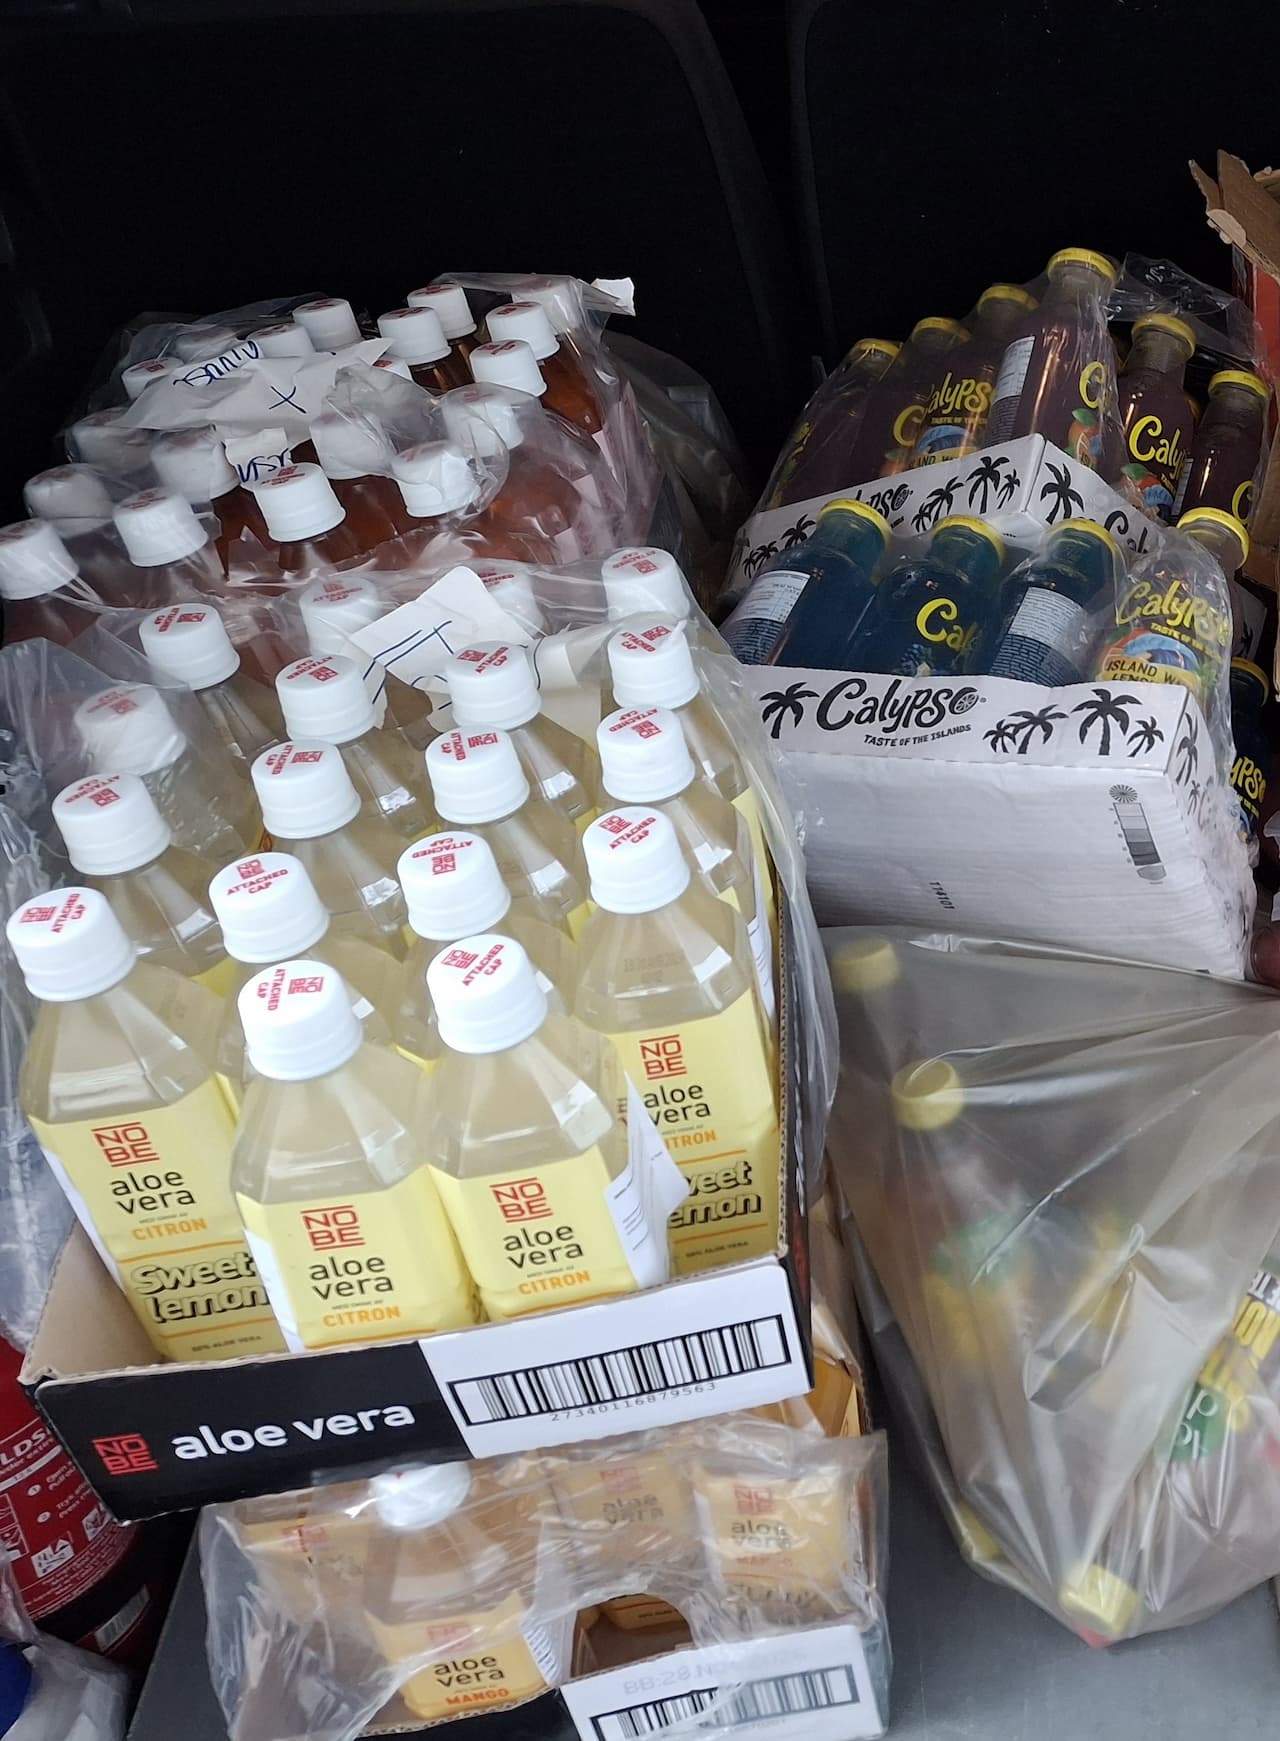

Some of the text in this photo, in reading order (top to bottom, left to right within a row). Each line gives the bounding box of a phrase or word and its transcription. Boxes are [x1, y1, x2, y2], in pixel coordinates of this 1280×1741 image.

[1106, 659, 1158, 677] ISLAND
[816, 678, 980, 734] Calypso
[864, 723, 972, 747] TASTE OF THE ISLANDS
[429, 837, 454, 847] CAP
[609, 817, 656, 849] ATTACHED
[630, 830, 650, 844] CAP
[412, 840, 473, 859] ATTACHED
[227, 869, 289, 895] ATTACHED
[248, 882, 272, 894] CAP
[461, 944, 505, 987] ATTACHED
[482, 958, 504, 976] CAP
[256, 982, 269, 999] CAP
[267, 969, 286, 1011] ATTACHED
[644, 1084, 703, 1109] aloe
[650, 1103, 711, 1127] vera
[665, 1130, 717, 1150] ITRON
[110, 1170, 185, 1197] aloe
[116, 1189, 196, 1215] vera
[668, 1192, 762, 1230] emon
[131, 1218, 208, 1242] CITRON
[503, 1225, 575, 1251] aloe
[309, 1256, 386, 1281] aloe
[506, 1244, 584, 1270] vera
[130, 1251, 258, 1296] Sweet
[517, 1270, 592, 1296] CITRON
[312, 1276, 394, 1301] vera
[145, 1285, 270, 1324] lemon
[323, 1305, 401, 1328] CITRON
[171, 1401, 416, 1460] aloe vera
[434, 1655, 498, 1677] aloe
[436, 1668, 505, 1687] vera
[446, 1688, 510, 1705] MANGO
